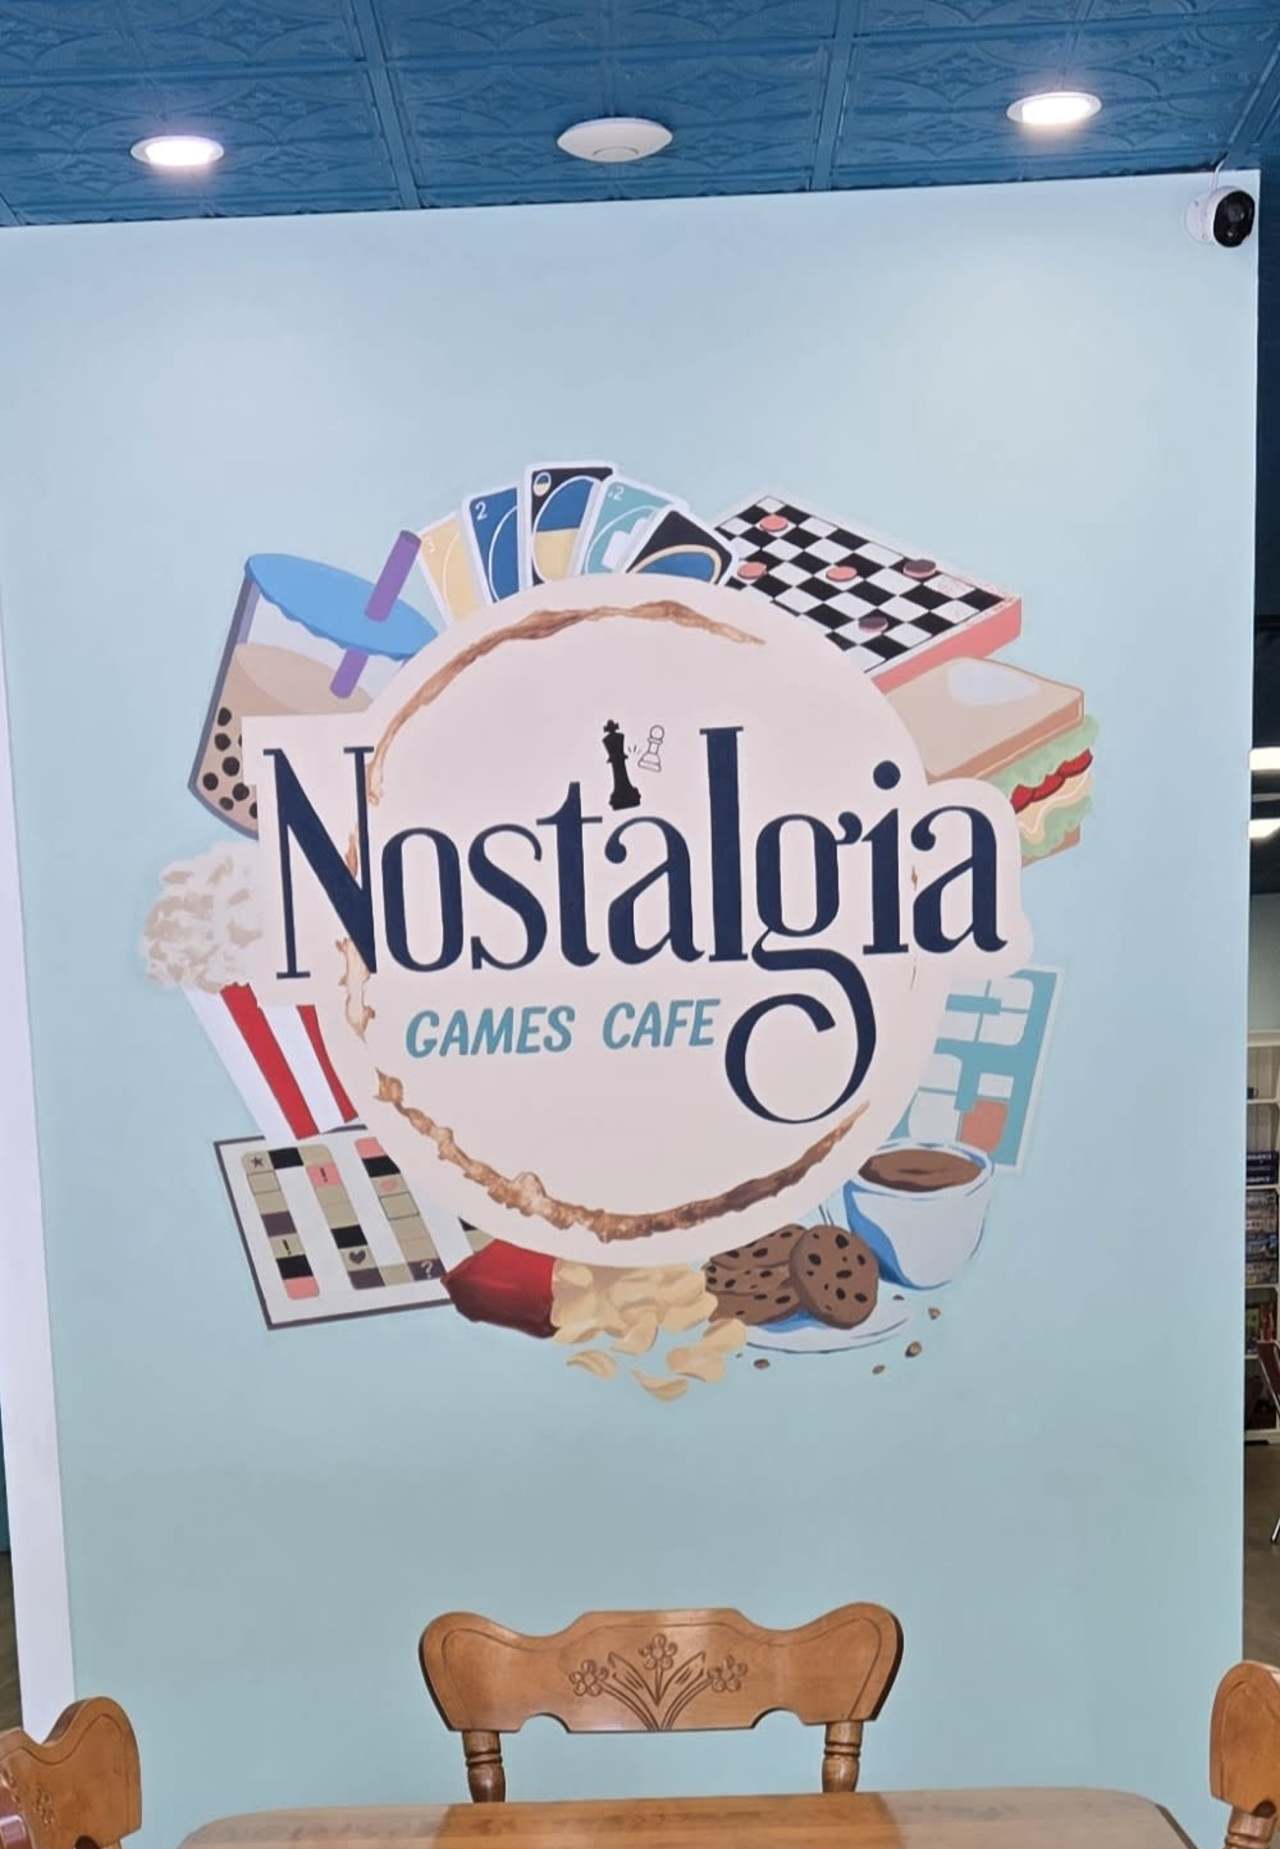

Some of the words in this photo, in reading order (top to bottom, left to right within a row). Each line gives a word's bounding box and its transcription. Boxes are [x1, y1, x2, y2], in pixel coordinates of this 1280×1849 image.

[263, 726, 1008, 1125] Nostalgia
[406, 1005, 576, 1059] GAMES
[602, 998, 722, 1050] CAFE
